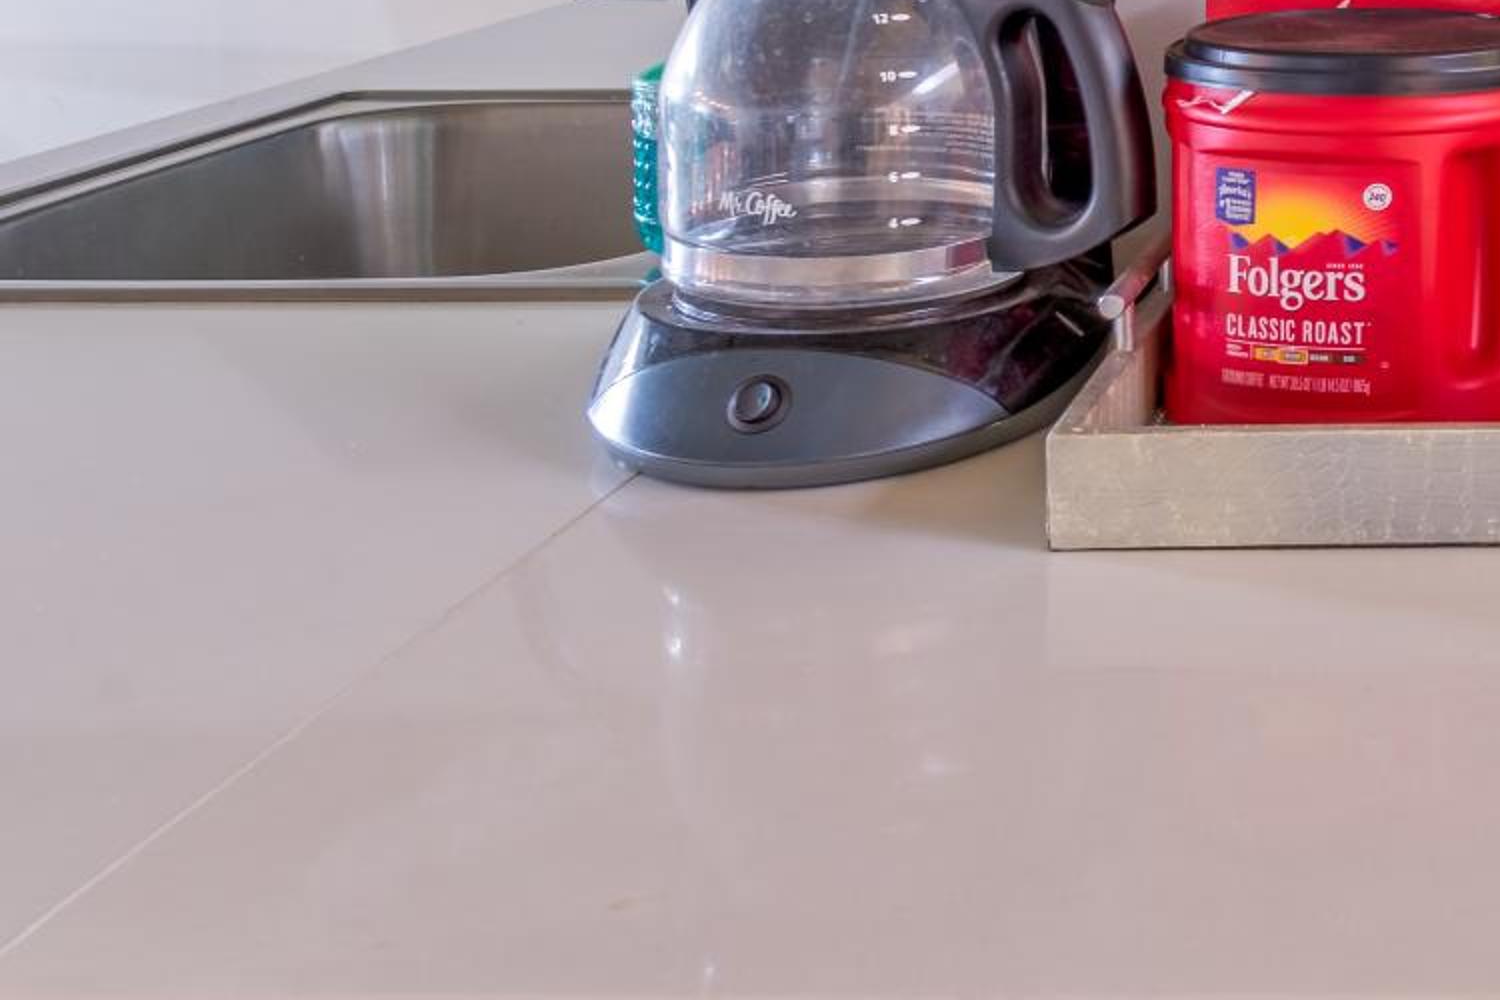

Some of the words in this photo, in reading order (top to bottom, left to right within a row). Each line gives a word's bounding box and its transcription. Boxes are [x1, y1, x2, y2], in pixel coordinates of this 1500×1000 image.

[872, 13, 889, 25] 12
[880, 71, 897, 83] 10
[888, 171, 899, 183] 6
[746, 191, 797, 226] Coffee
[888, 217, 899, 229] 4
[1224, 253, 1367, 311] Folgers
[1225, 312, 1296, 342] CLASSIC
[1302, 320, 1366, 345] ROAST
